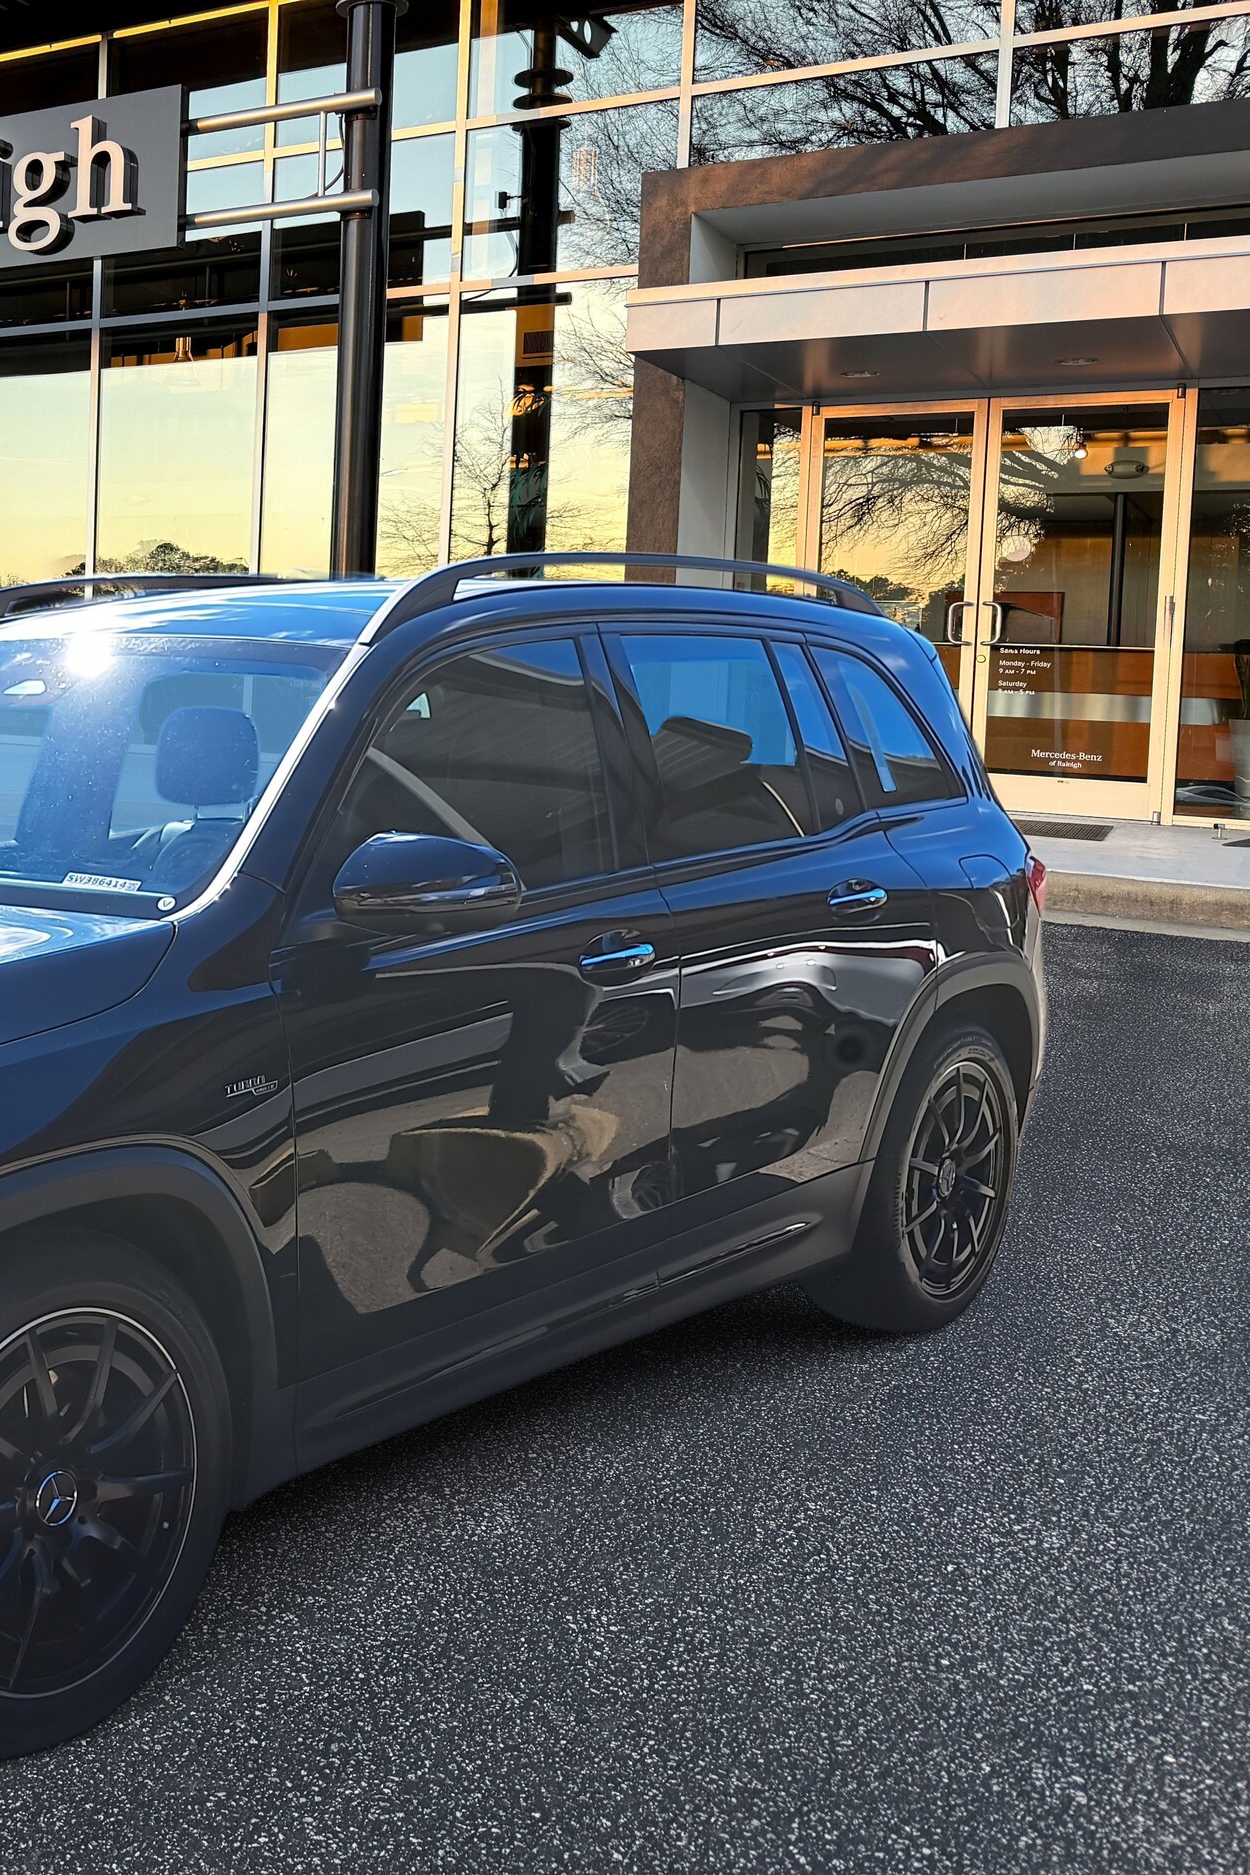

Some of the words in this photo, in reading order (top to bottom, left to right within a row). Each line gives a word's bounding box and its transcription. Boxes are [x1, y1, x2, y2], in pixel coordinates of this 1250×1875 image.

[999, 659, 1025, 668] Monday
[1030, 660, 1051, 669] Friday
[998, 667, 1004, 675] 9
[997, 679, 1028, 688] Saturday
[1030, 749, 1103, 762] Mercedes-Benz
[1057, 760, 1082, 769] Raleigh
